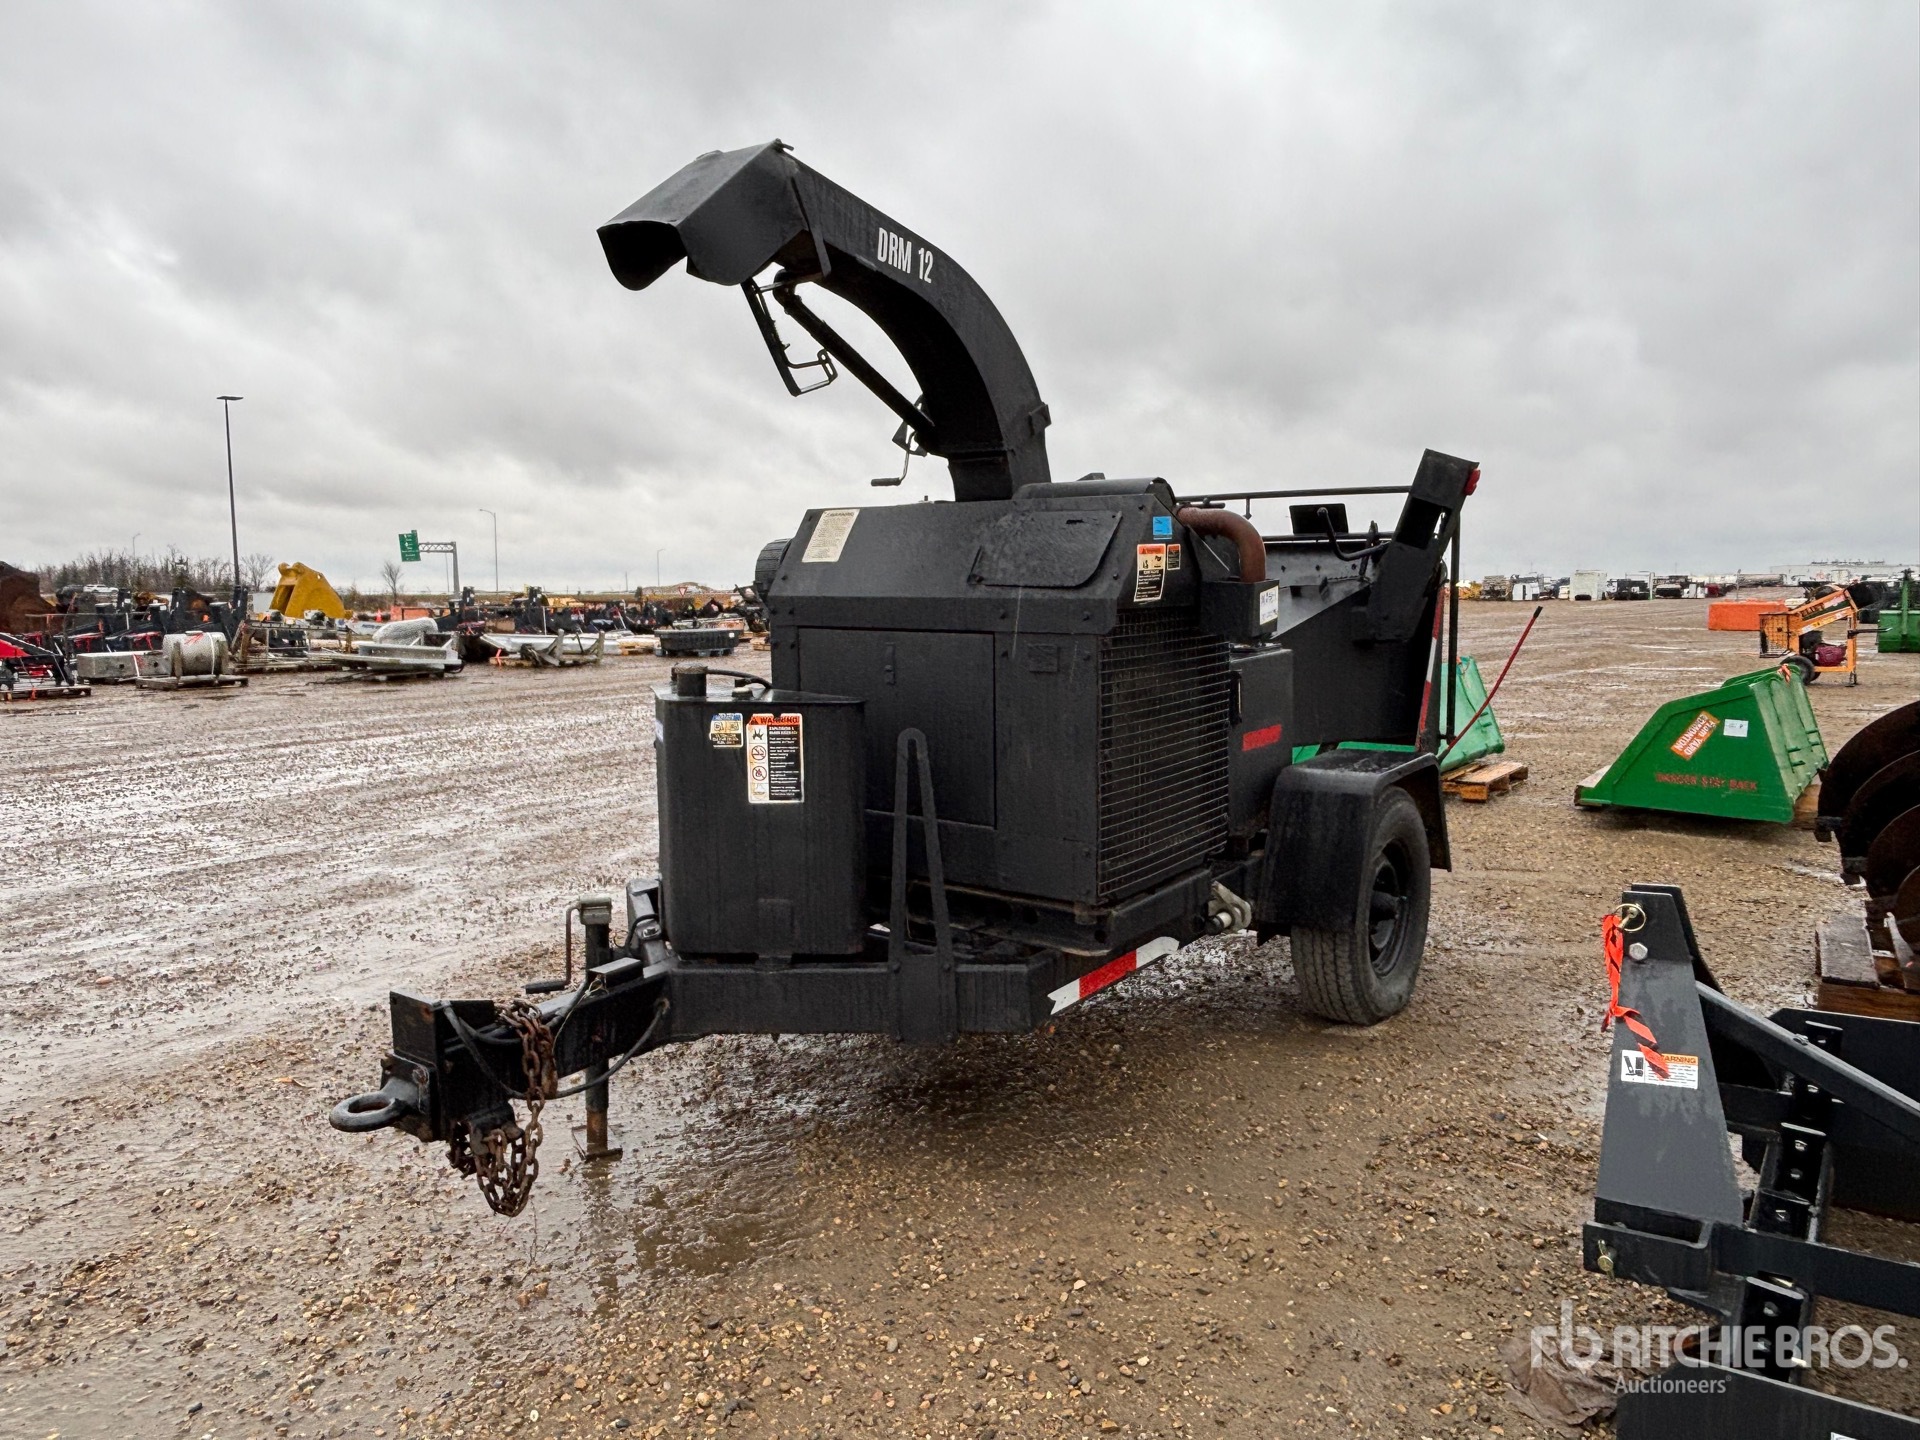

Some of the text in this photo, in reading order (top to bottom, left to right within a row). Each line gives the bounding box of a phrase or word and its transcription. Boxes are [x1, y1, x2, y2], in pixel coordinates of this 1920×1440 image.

[878, 227, 934, 284] DRM 12
[1661, 1055, 1697, 1064] ARNING
